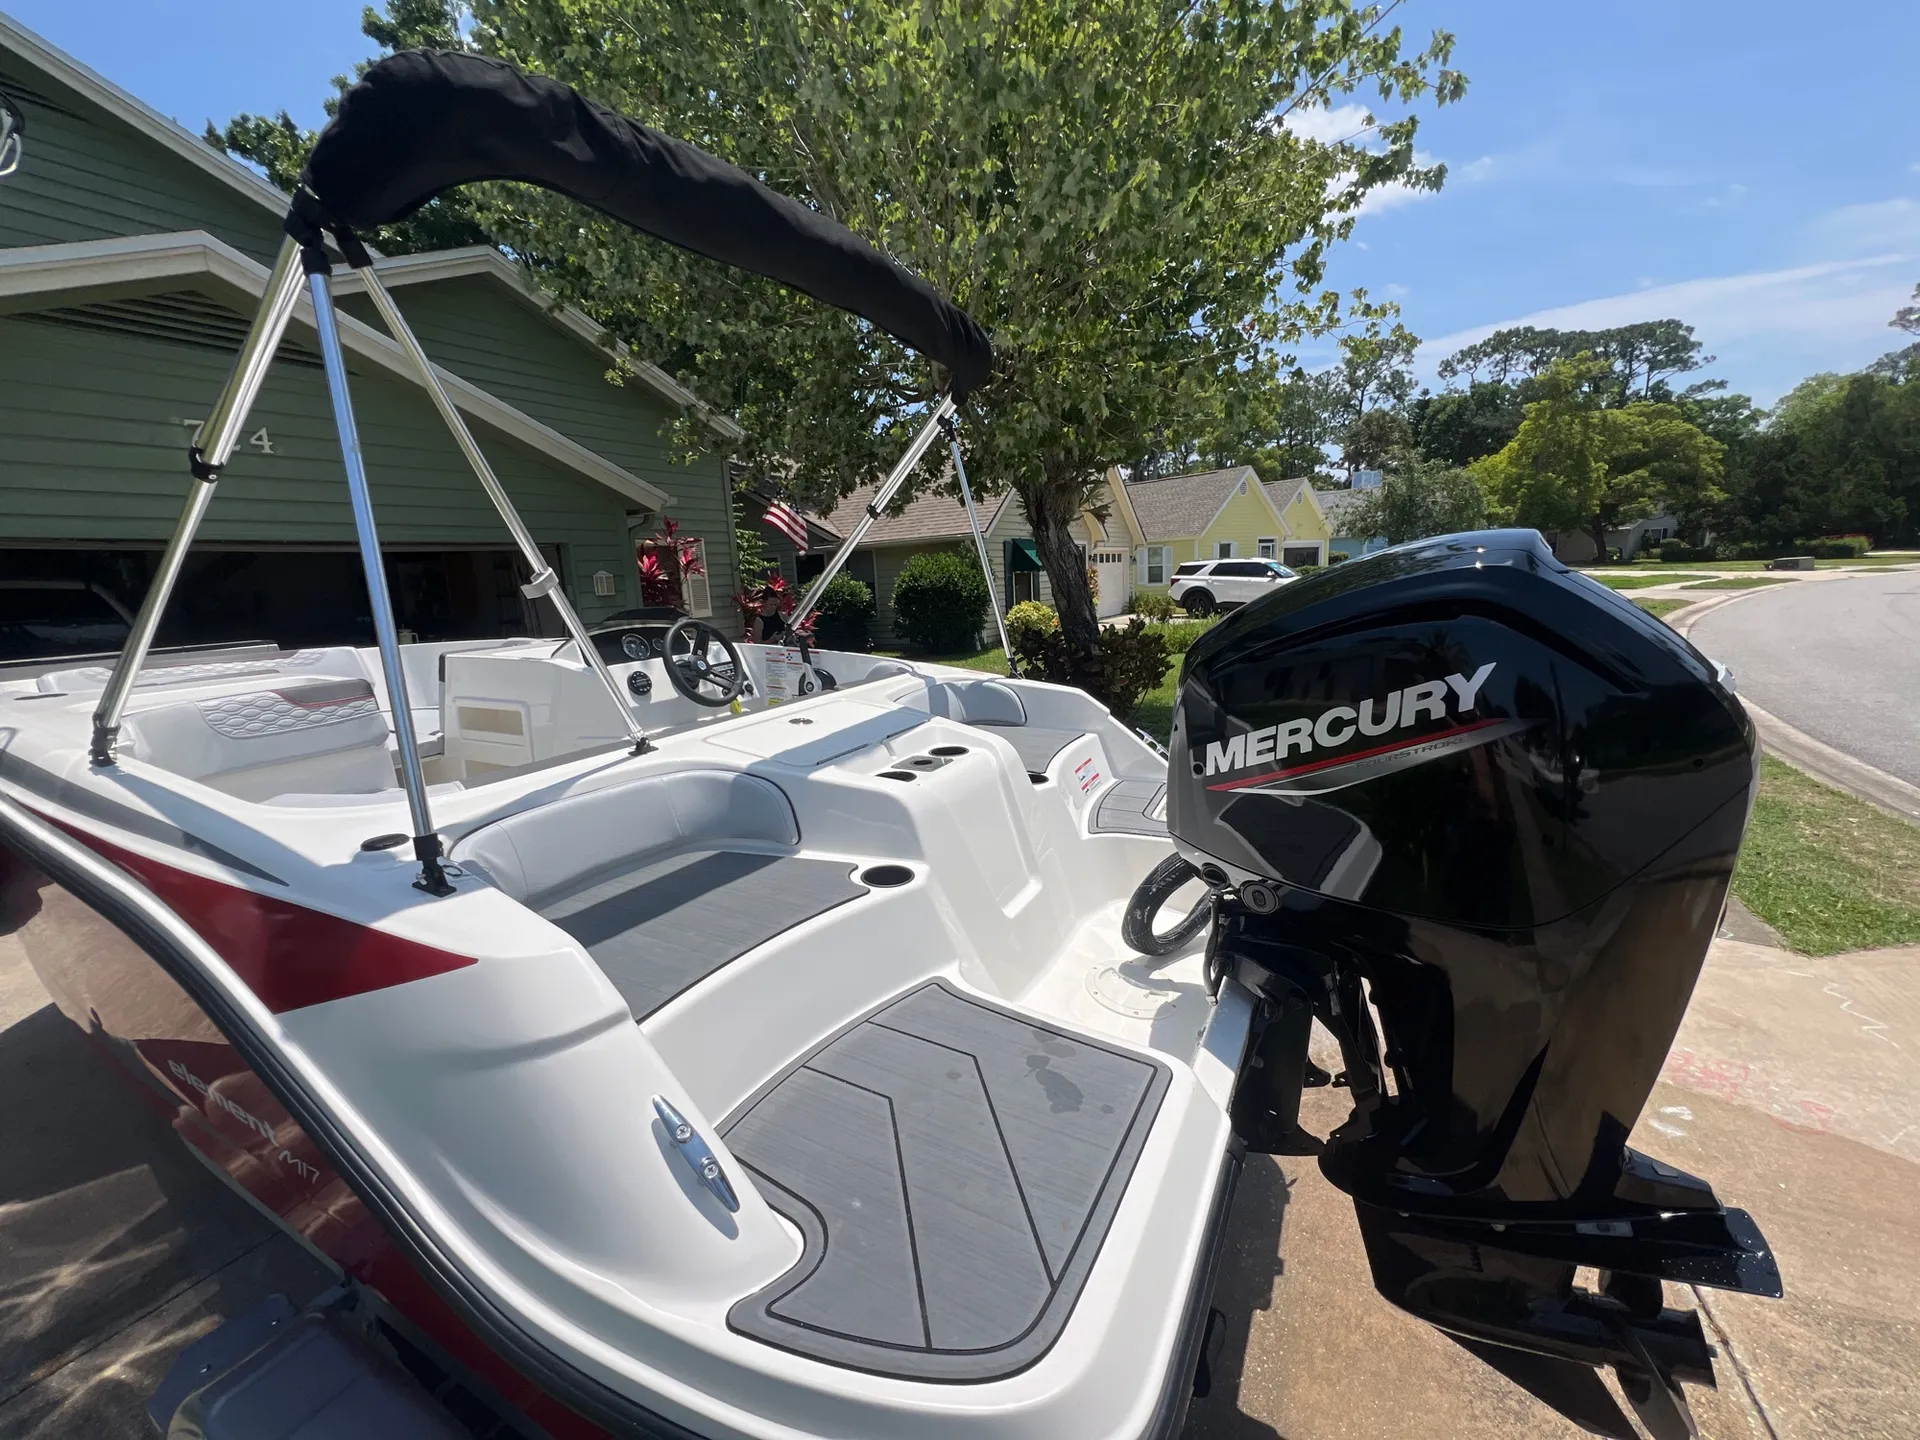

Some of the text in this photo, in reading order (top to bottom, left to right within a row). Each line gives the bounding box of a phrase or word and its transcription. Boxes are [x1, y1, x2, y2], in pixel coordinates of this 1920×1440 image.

[183, 419, 275, 454] 74
[1205, 662, 1497, 776] MERCURY
[1355, 734, 1469, 769] FOURSTROKE
[168, 1059, 320, 1184] element M17
